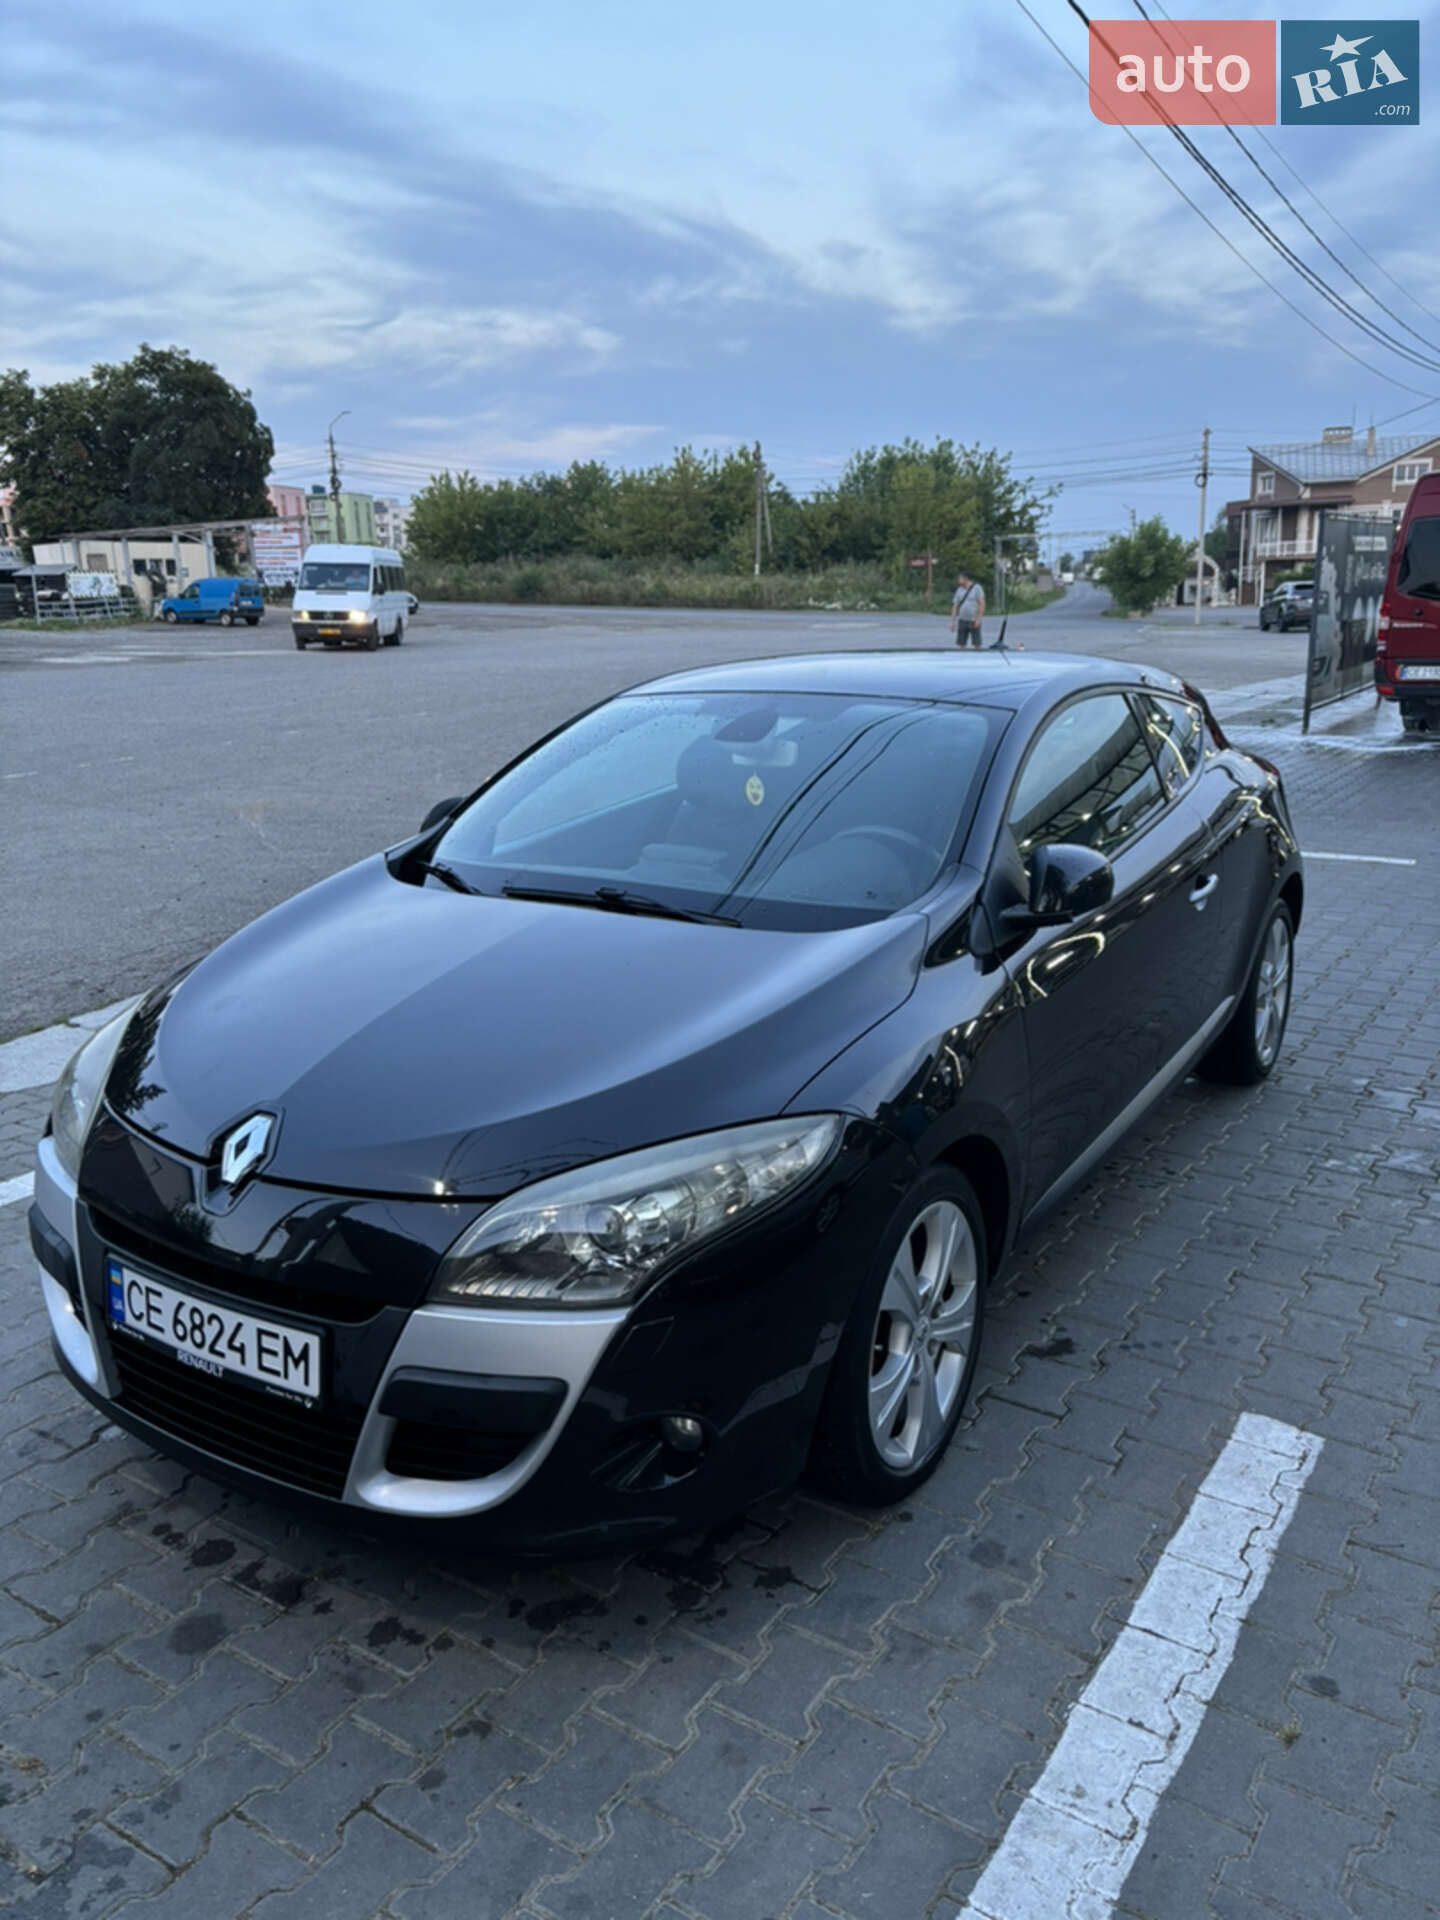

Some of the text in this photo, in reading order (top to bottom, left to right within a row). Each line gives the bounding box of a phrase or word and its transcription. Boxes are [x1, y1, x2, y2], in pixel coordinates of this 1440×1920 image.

[127, 1280, 310, 1387] CE 6824 EM
